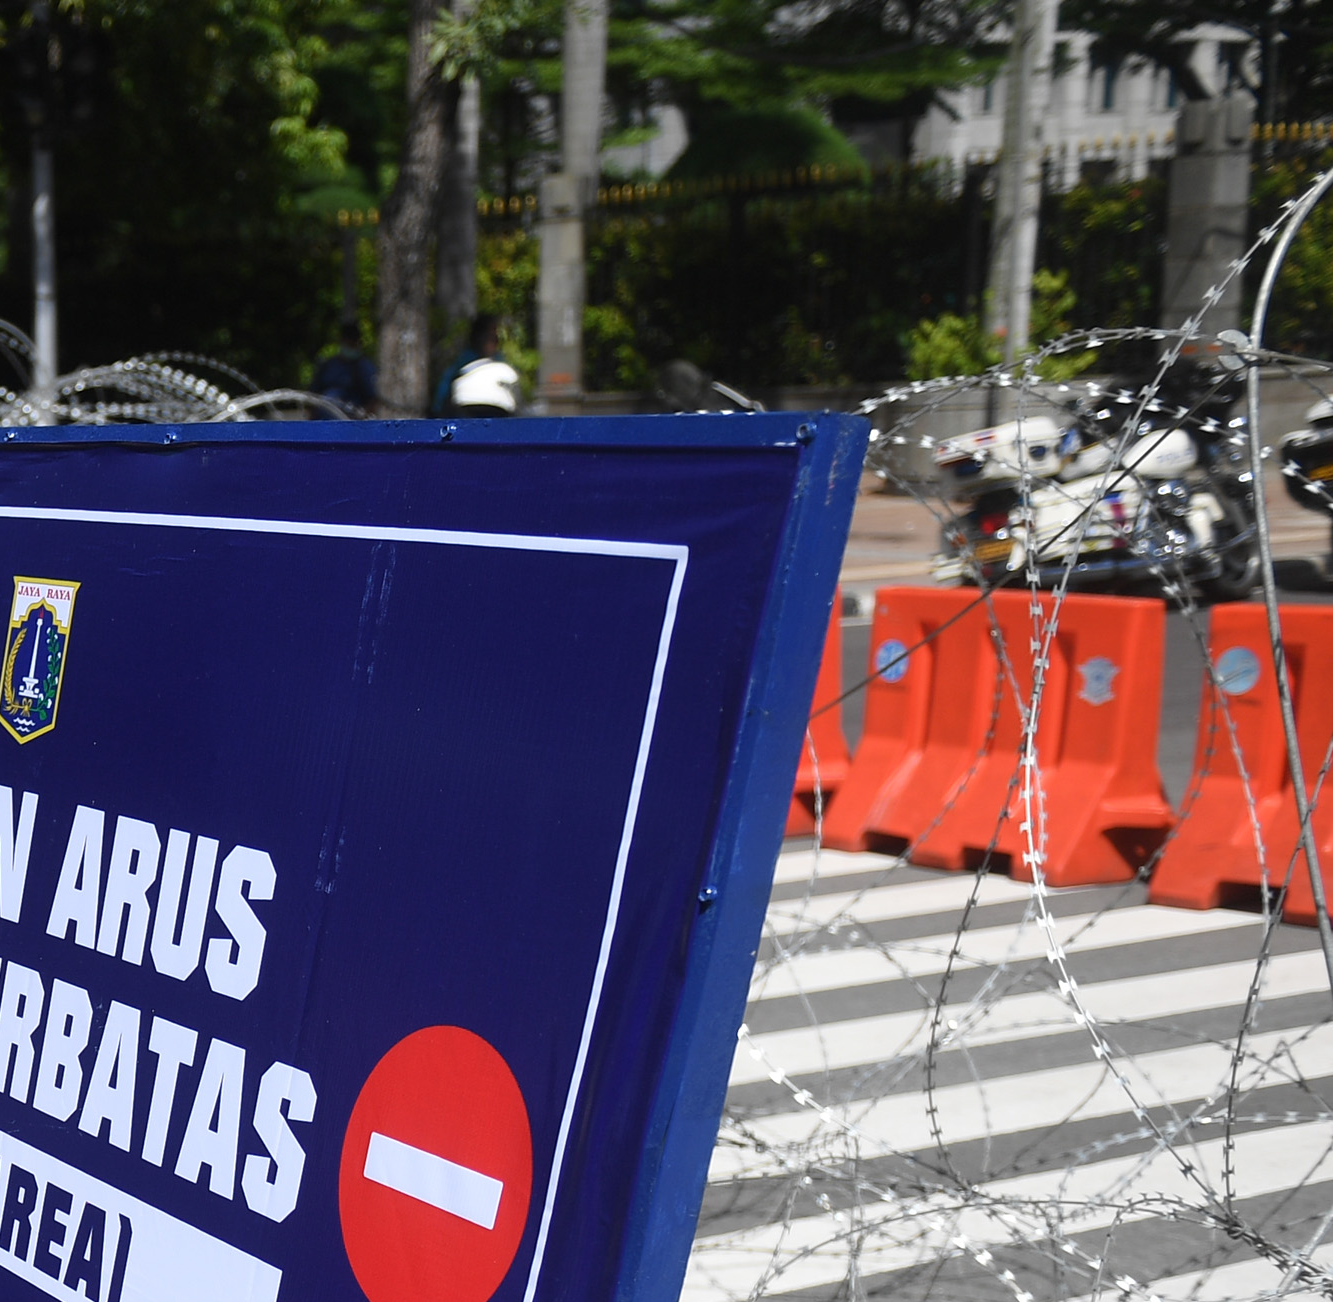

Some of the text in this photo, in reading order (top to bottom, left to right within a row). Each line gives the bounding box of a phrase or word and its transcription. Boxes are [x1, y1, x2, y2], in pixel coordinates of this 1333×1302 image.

[18, 585, 71, 601] JAYA RAYA
[46, 804, 277, 1001] ARUS
